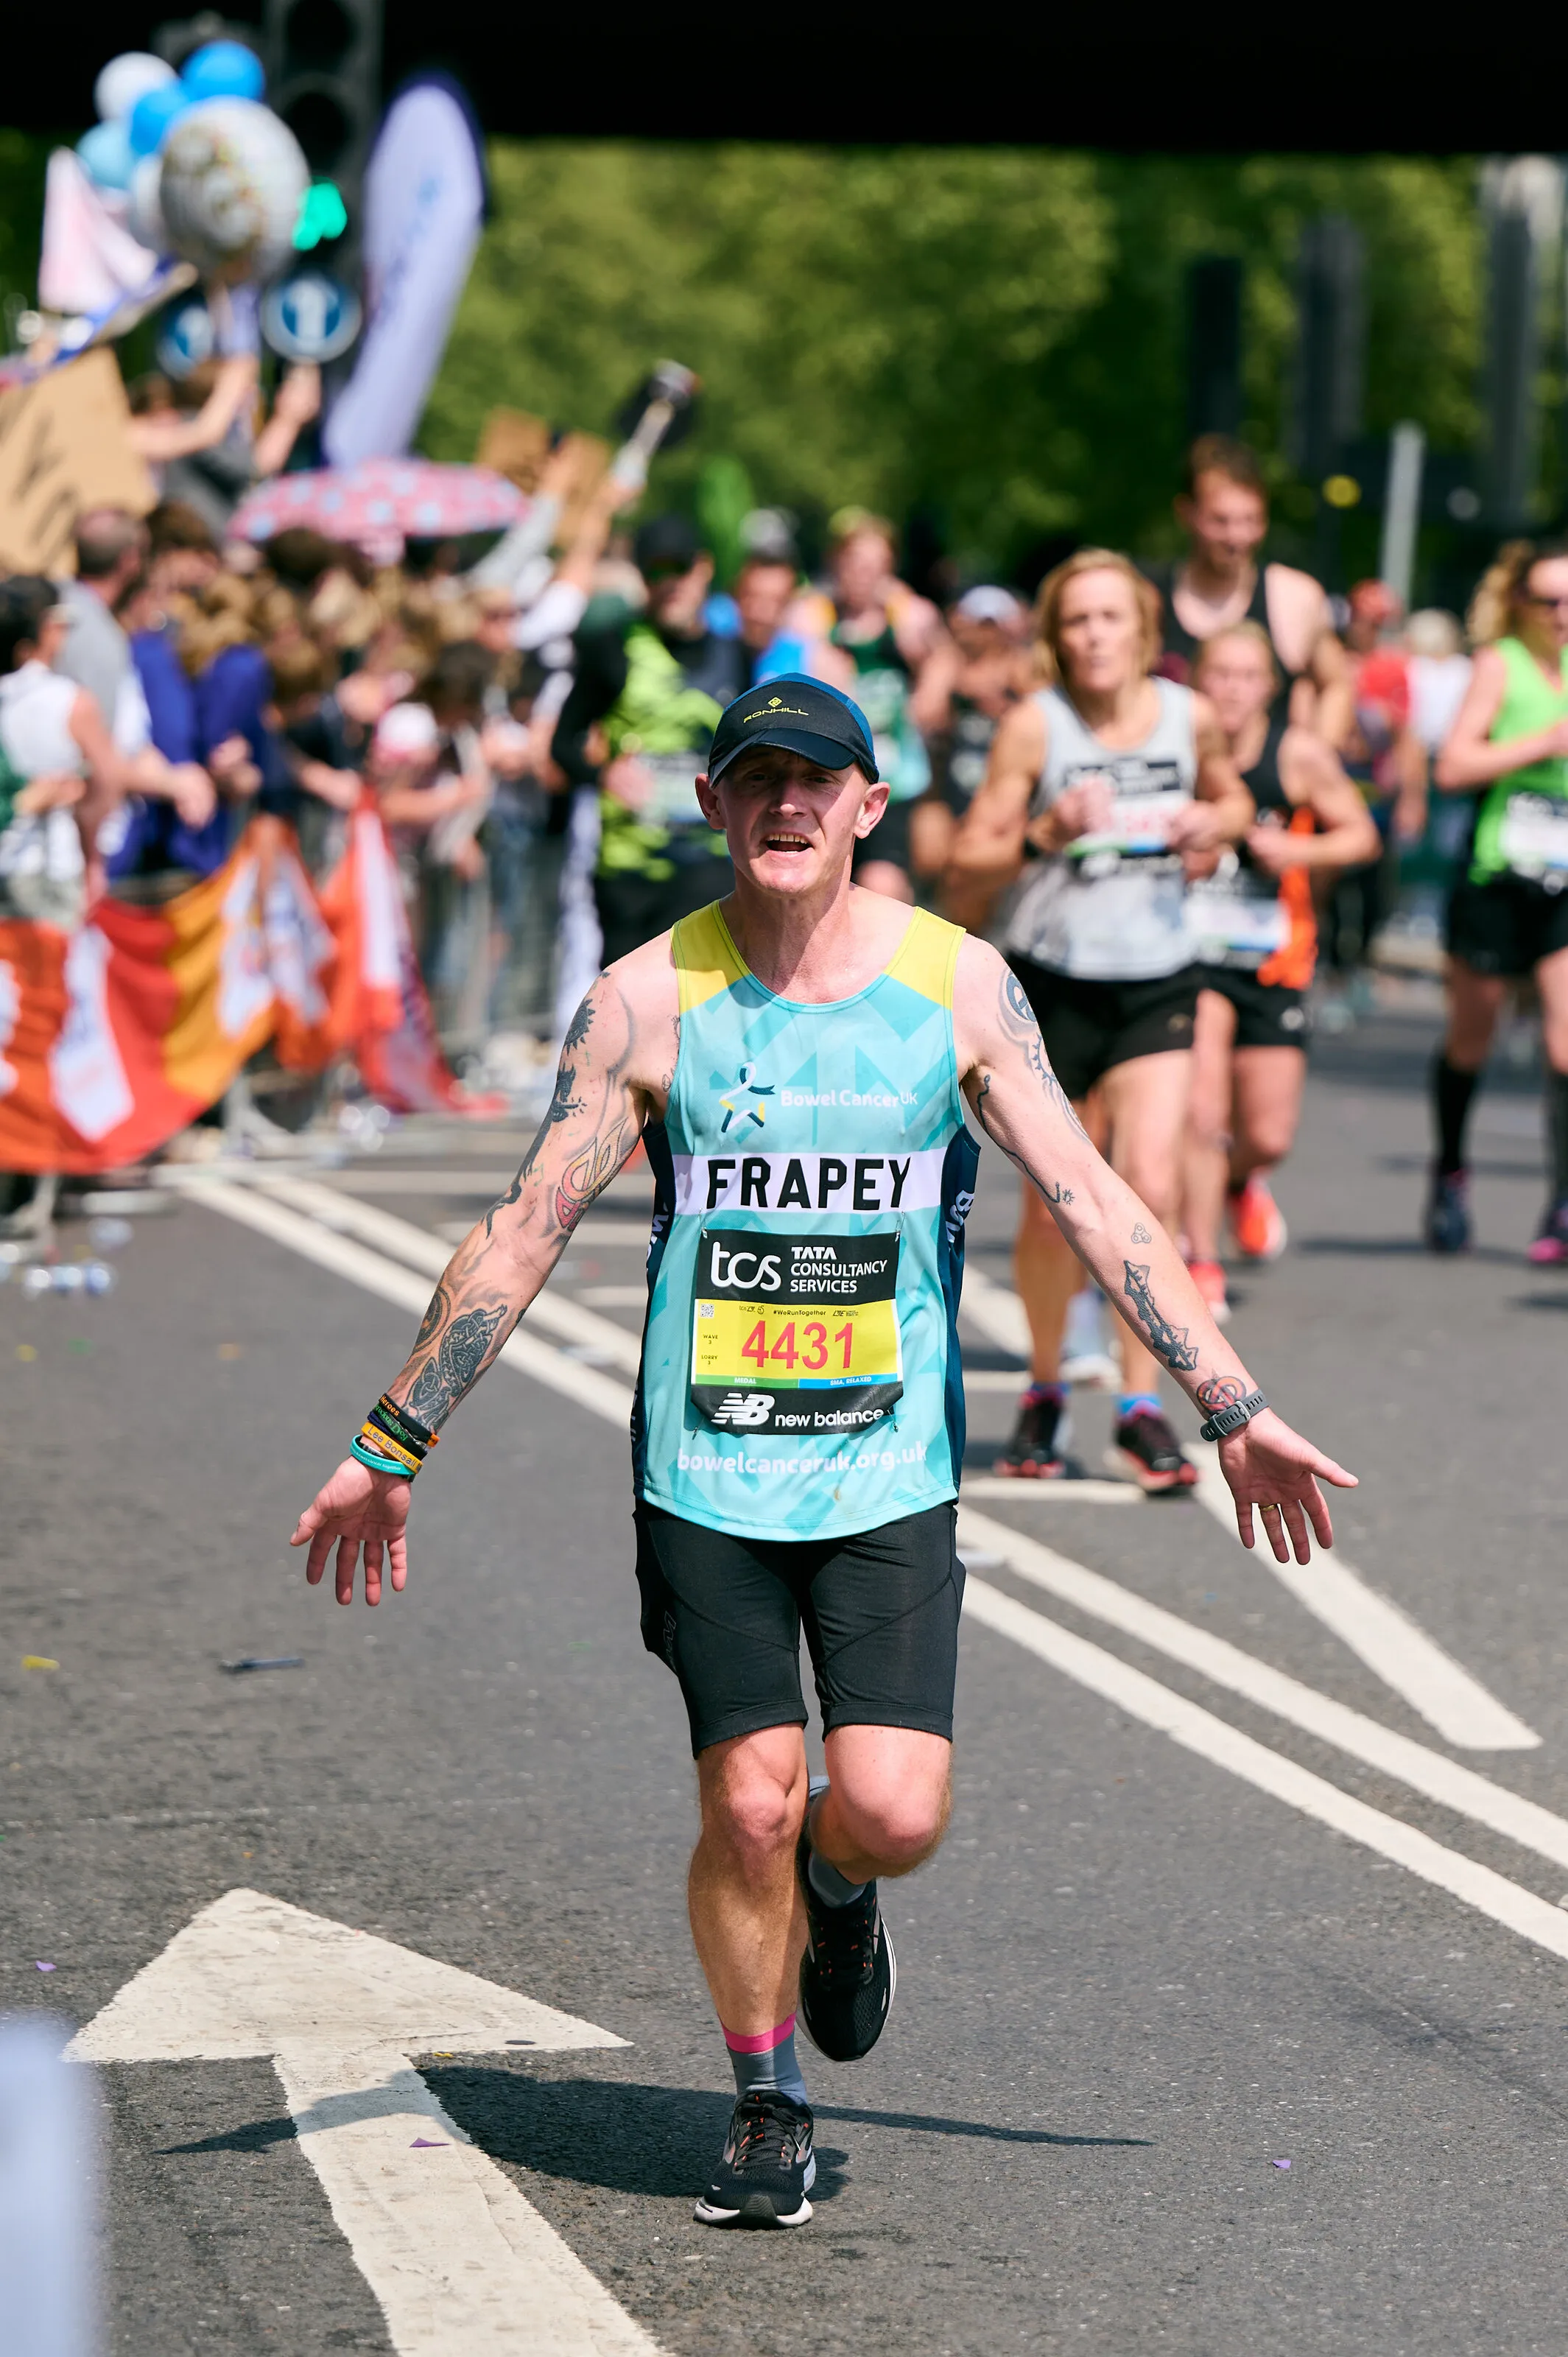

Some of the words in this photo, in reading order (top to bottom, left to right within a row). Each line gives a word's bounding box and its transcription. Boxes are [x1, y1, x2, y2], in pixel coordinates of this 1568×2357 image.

[743, 707, 809, 723] RONHILL
[781, 1089, 837, 1106] Bowel
[706, 1156, 911, 1210] FRAPEY
[791, 1246, 837, 1260] TATA
[711, 1241, 781, 1290] tcs
[790, 1260, 887, 1276] CONSULTANCY
[790, 1280, 857, 1293] SERVICES
[741, 1319, 854, 1370] 4431
[846, 1376, 872, 1384] RELAXED
[380, 1395, 400, 1416] Heroes
[775, 1413, 809, 1427] new
[814, 1408, 884, 1427] balance
[368, 1425, 383, 1442] Lee
[677, 1440, 928, 1474] bowelcanceruk.org.uk
